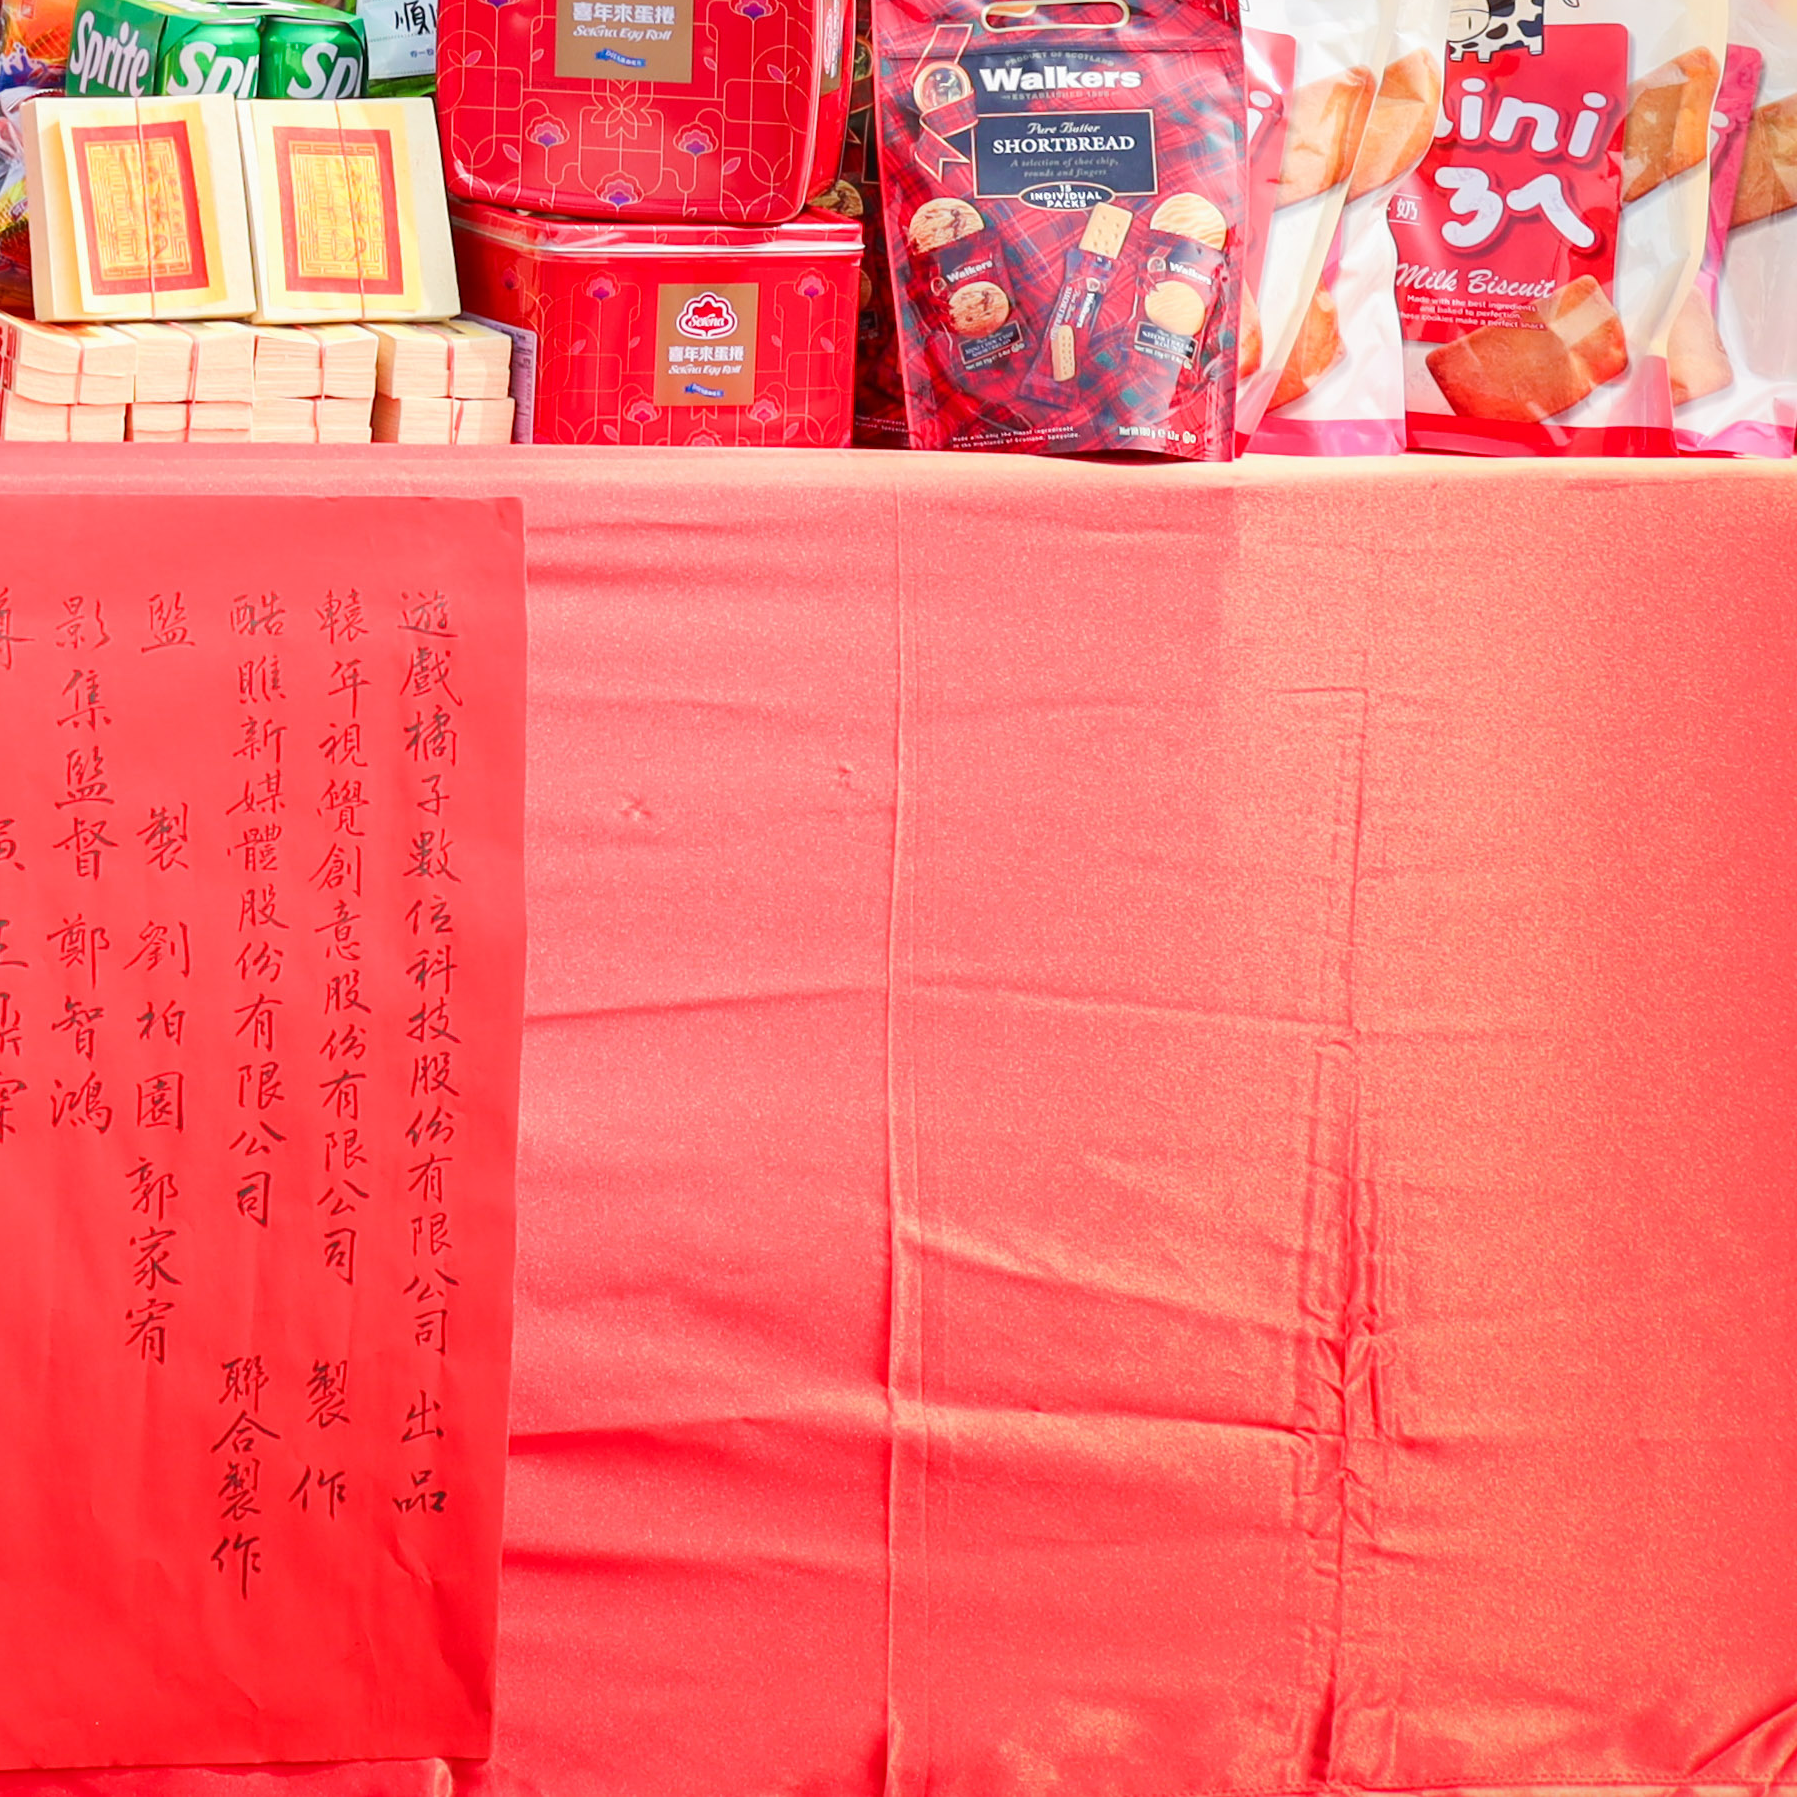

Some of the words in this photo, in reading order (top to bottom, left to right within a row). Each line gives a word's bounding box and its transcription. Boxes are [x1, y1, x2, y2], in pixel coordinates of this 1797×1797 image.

[573, 2, 675, 25] 喜年來蛋捲
[573, 24, 619, 39] Serena
[619, 28, 645, 42] Egg
[645, 28, 673, 41] Roll
[69, 10, 152, 96] Sprite
[978, 65, 1142, 92] Walkers
[1026, 122, 1057, 135] Pure
[1059, 121, 1101, 134] Butter
[1433, 77, 1608, 158] ini
[992, 135, 1136, 154] SHORTBREAD
[1030, 192, 1103, 201] INDIVIDUAL
[1046, 200, 1087, 209] PACKS
[1396, 262, 1459, 293] Milk
[1467, 269, 1557, 299] Biscuit
[288, 1359, 350, 1519] 製作
[392, 1390, 450, 1514] 出品
